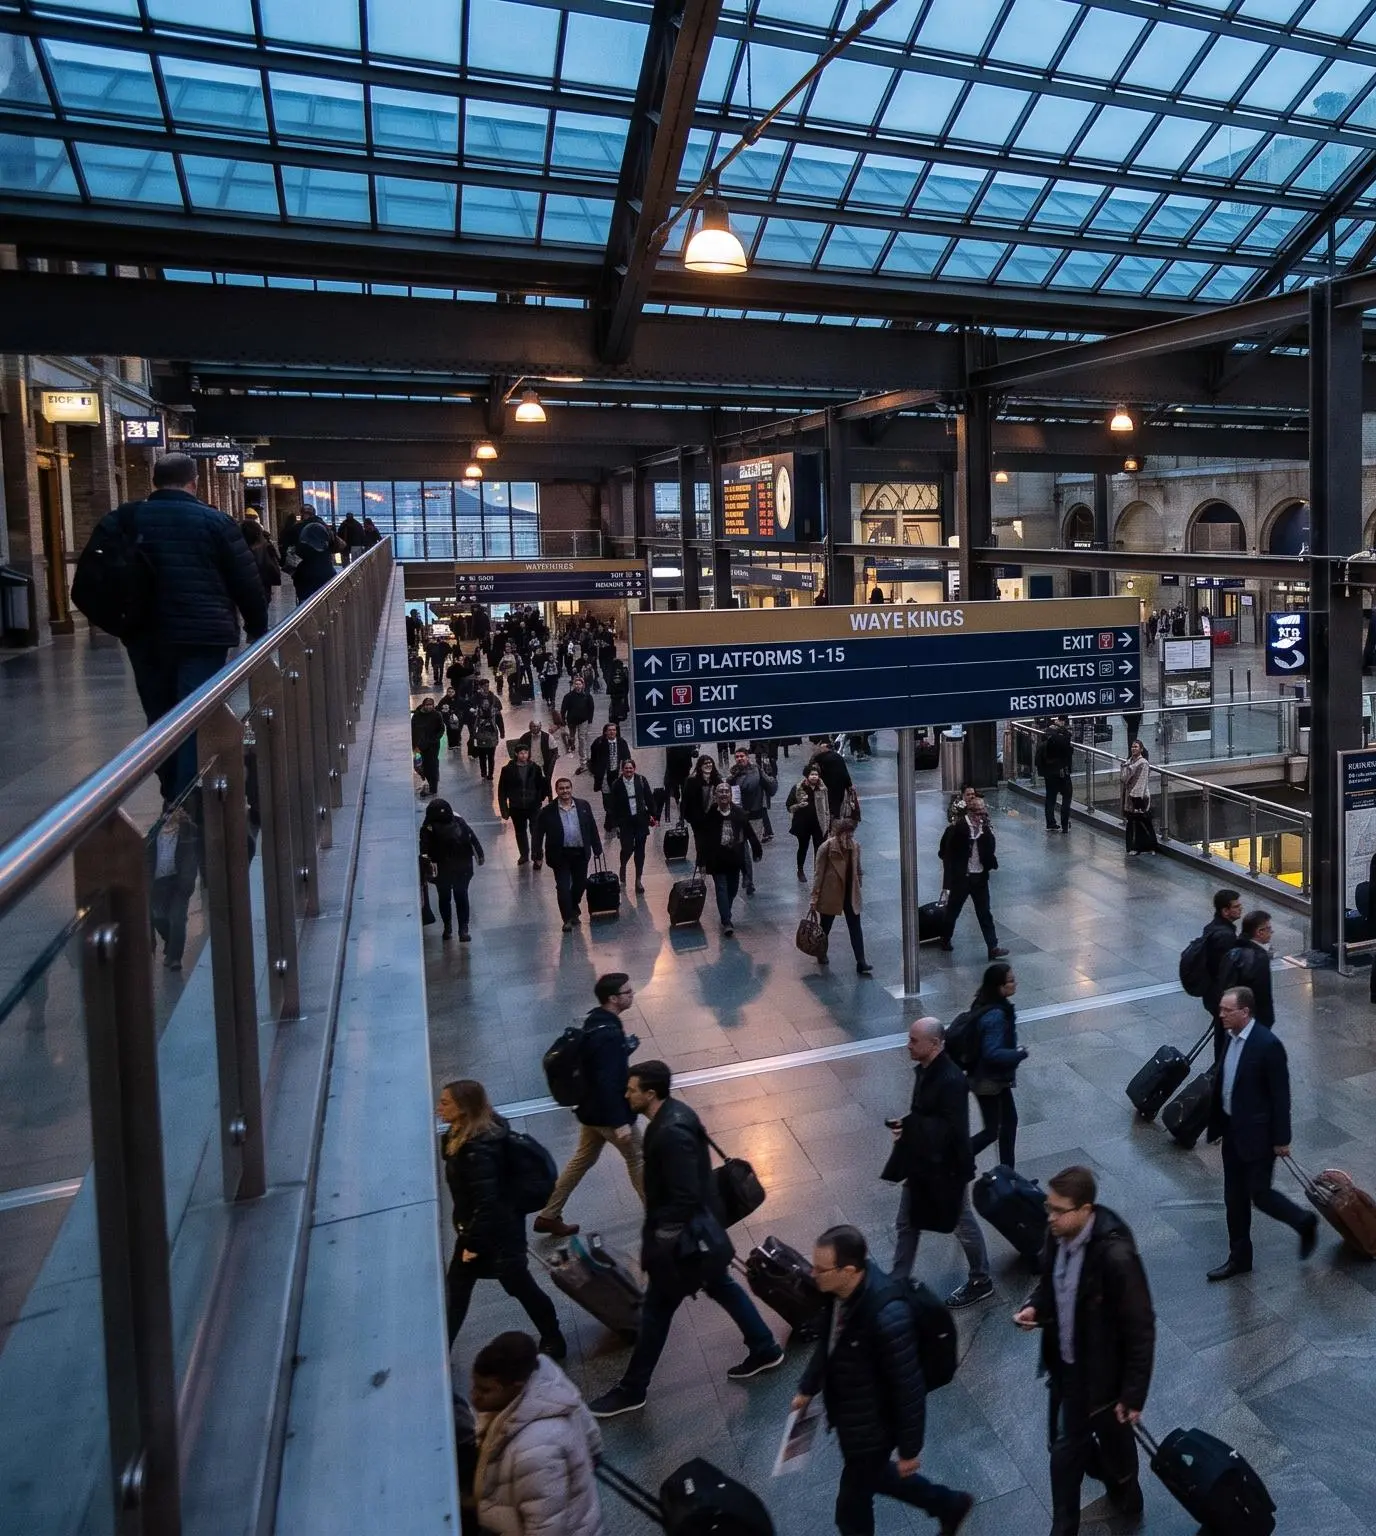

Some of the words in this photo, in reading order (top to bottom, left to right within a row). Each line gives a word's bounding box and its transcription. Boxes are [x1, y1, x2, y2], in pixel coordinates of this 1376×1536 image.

[1063, 634, 1094, 650] EXIT
[698, 648, 803, 670] PLATFORMS
[808, 647, 845, 664] 1-15
[1036, 662, 1095, 680] TICKETS
[699, 684, 738, 702] EXIT
[1010, 690, 1096, 711] RESTROOMS
[699, 714, 773, 735] TICKETS
